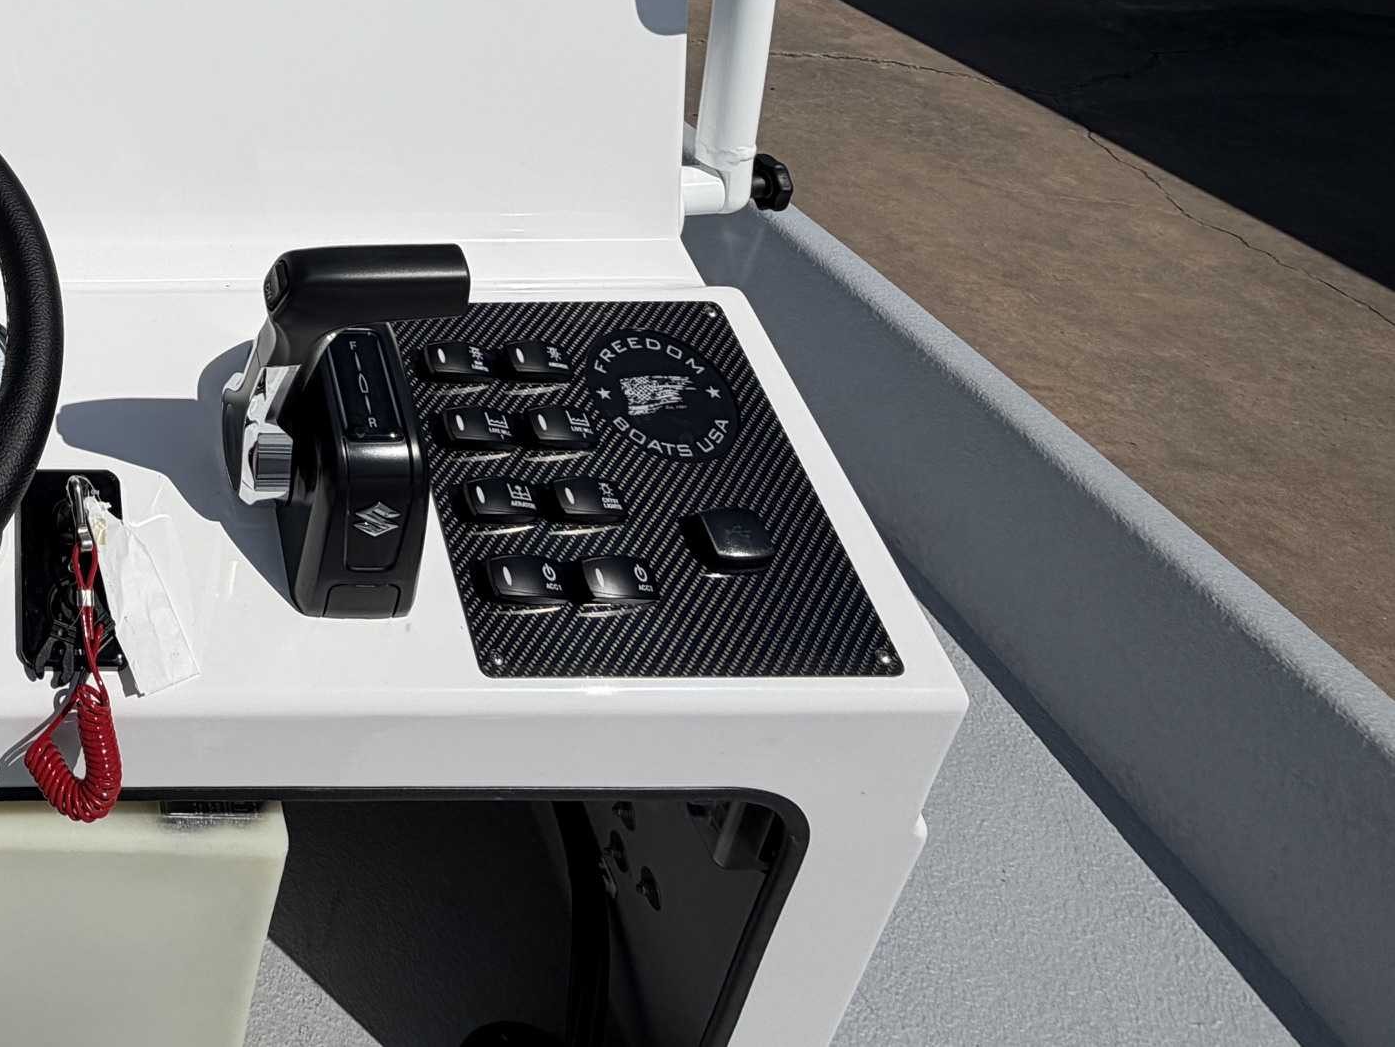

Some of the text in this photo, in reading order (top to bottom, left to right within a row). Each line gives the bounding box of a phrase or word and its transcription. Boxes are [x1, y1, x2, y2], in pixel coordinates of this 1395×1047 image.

[349, 340, 357, 351] F
[594, 337, 704, 374] FREEDOM
[367, 417, 378, 428] R
[613, 416, 729, 457] BOATS USA
